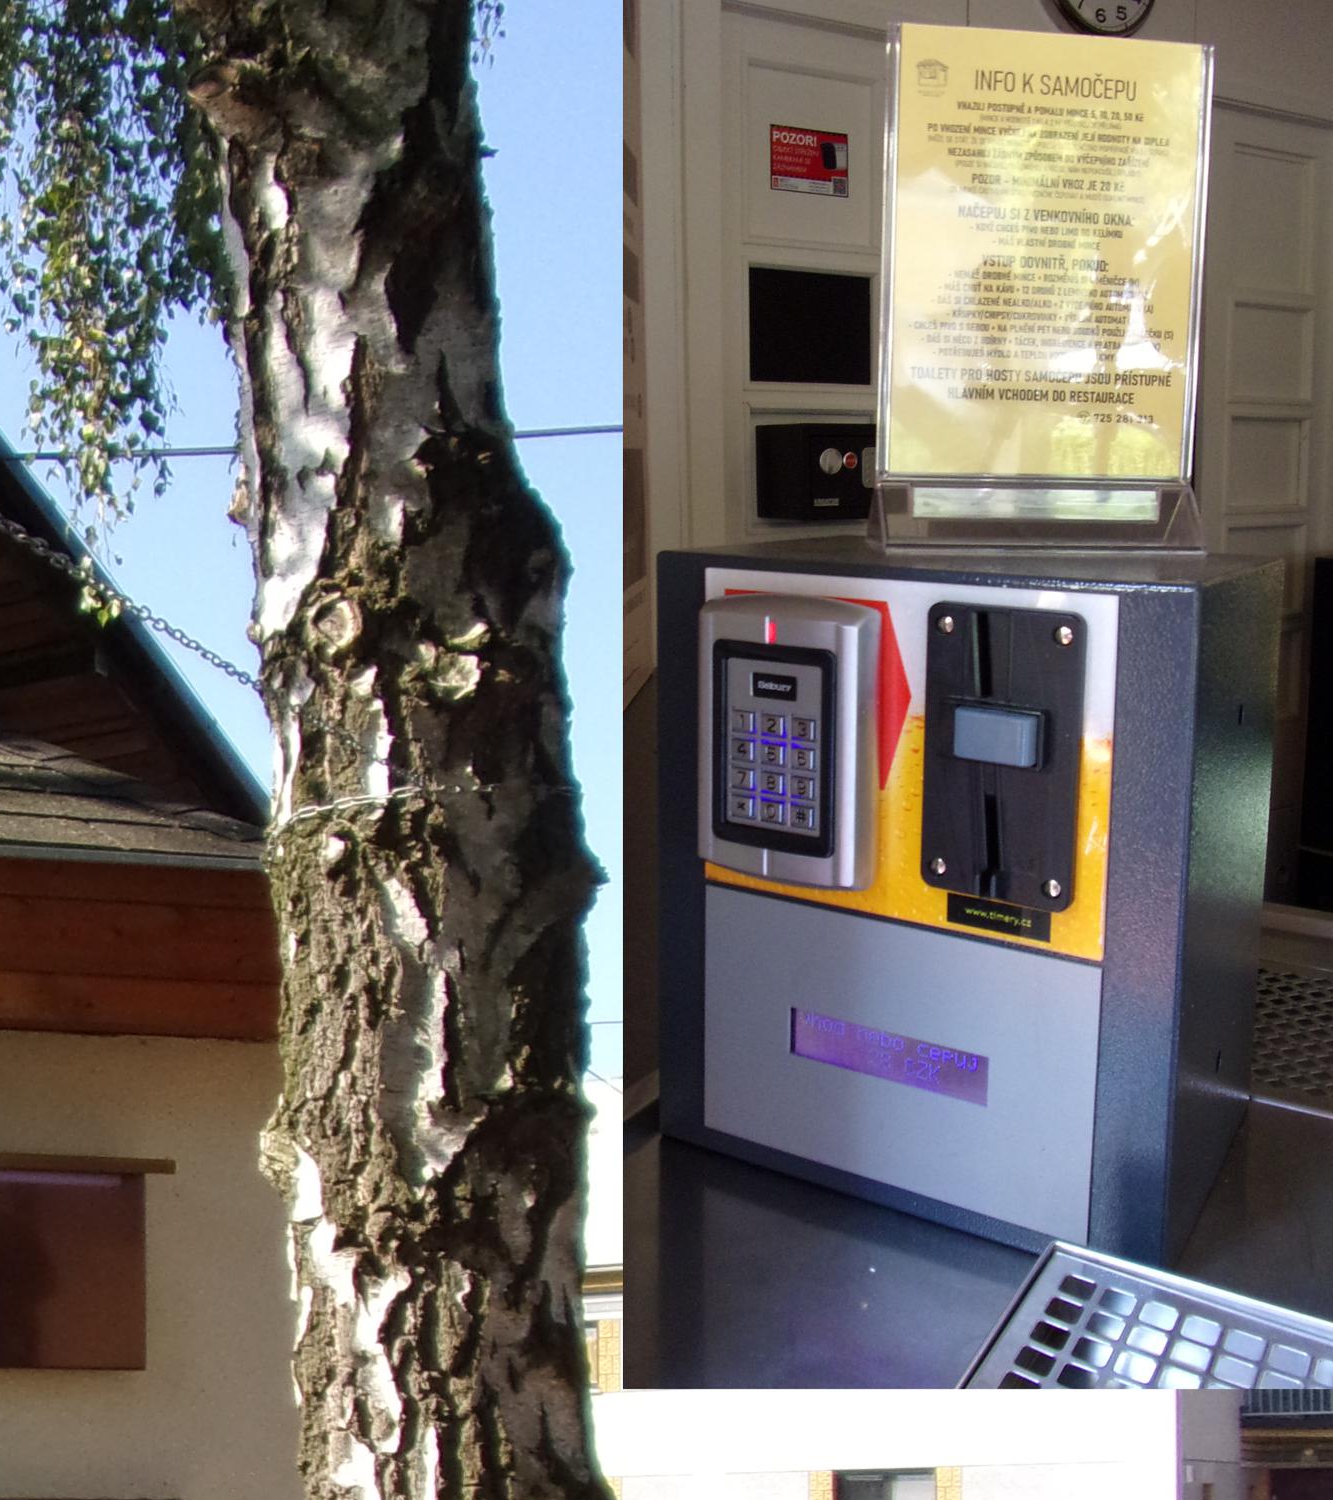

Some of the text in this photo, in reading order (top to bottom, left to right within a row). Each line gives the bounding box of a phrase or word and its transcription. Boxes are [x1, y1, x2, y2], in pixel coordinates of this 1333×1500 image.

[1095, 8, 1106, 23] 6
[1116, 6, 1127, 20] 5
[974, 69, 1137, 102] INFO K SAMOČEPU
[1033, 208, 1100, 226] VENKOVNÍHO
[998, 388, 1049, 402] VCHODEM
[1052, 390, 1066, 402] DO
[1069, 390, 1136, 405] RESTAURACE
[766, 718, 777, 734] 2
